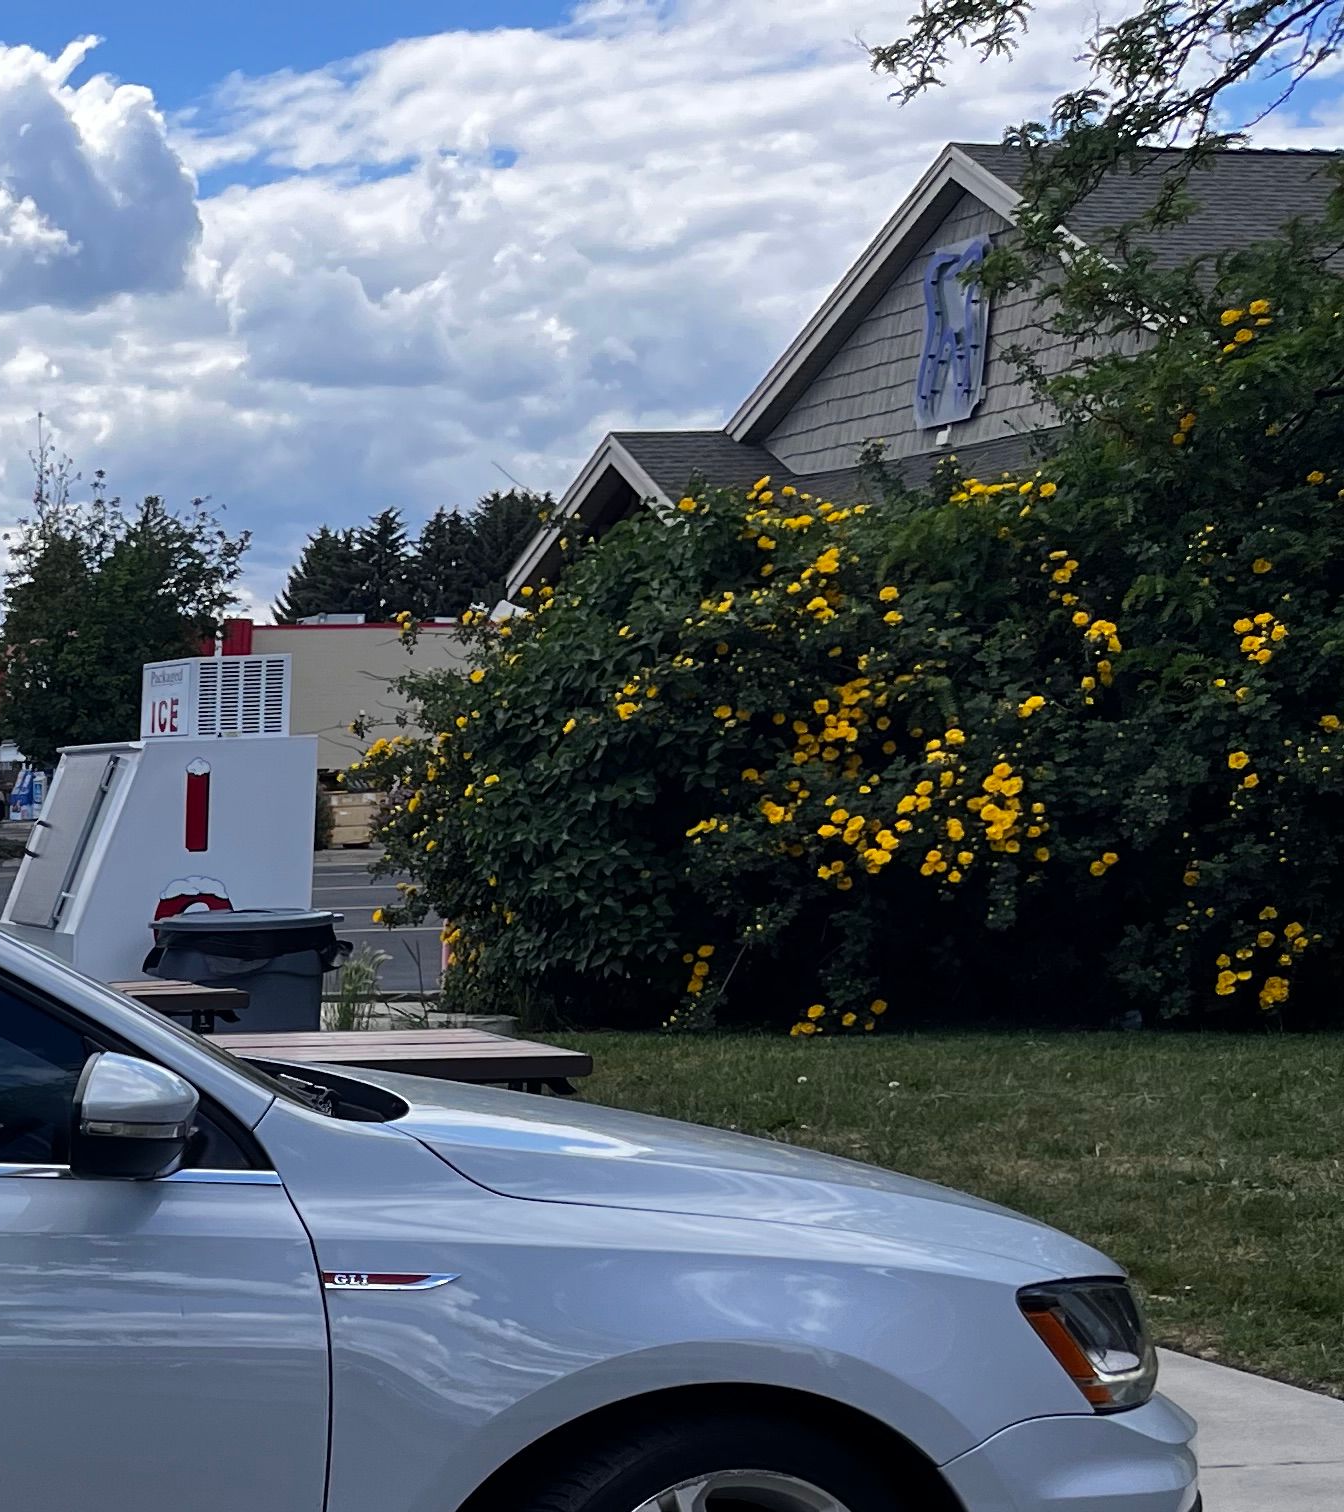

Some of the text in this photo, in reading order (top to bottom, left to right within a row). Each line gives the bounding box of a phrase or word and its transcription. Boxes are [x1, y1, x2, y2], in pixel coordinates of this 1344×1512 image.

[150, 669, 184, 687] Packaged
[150, 697, 180, 734] ICE
[333, 1274, 369, 1286] GLI
